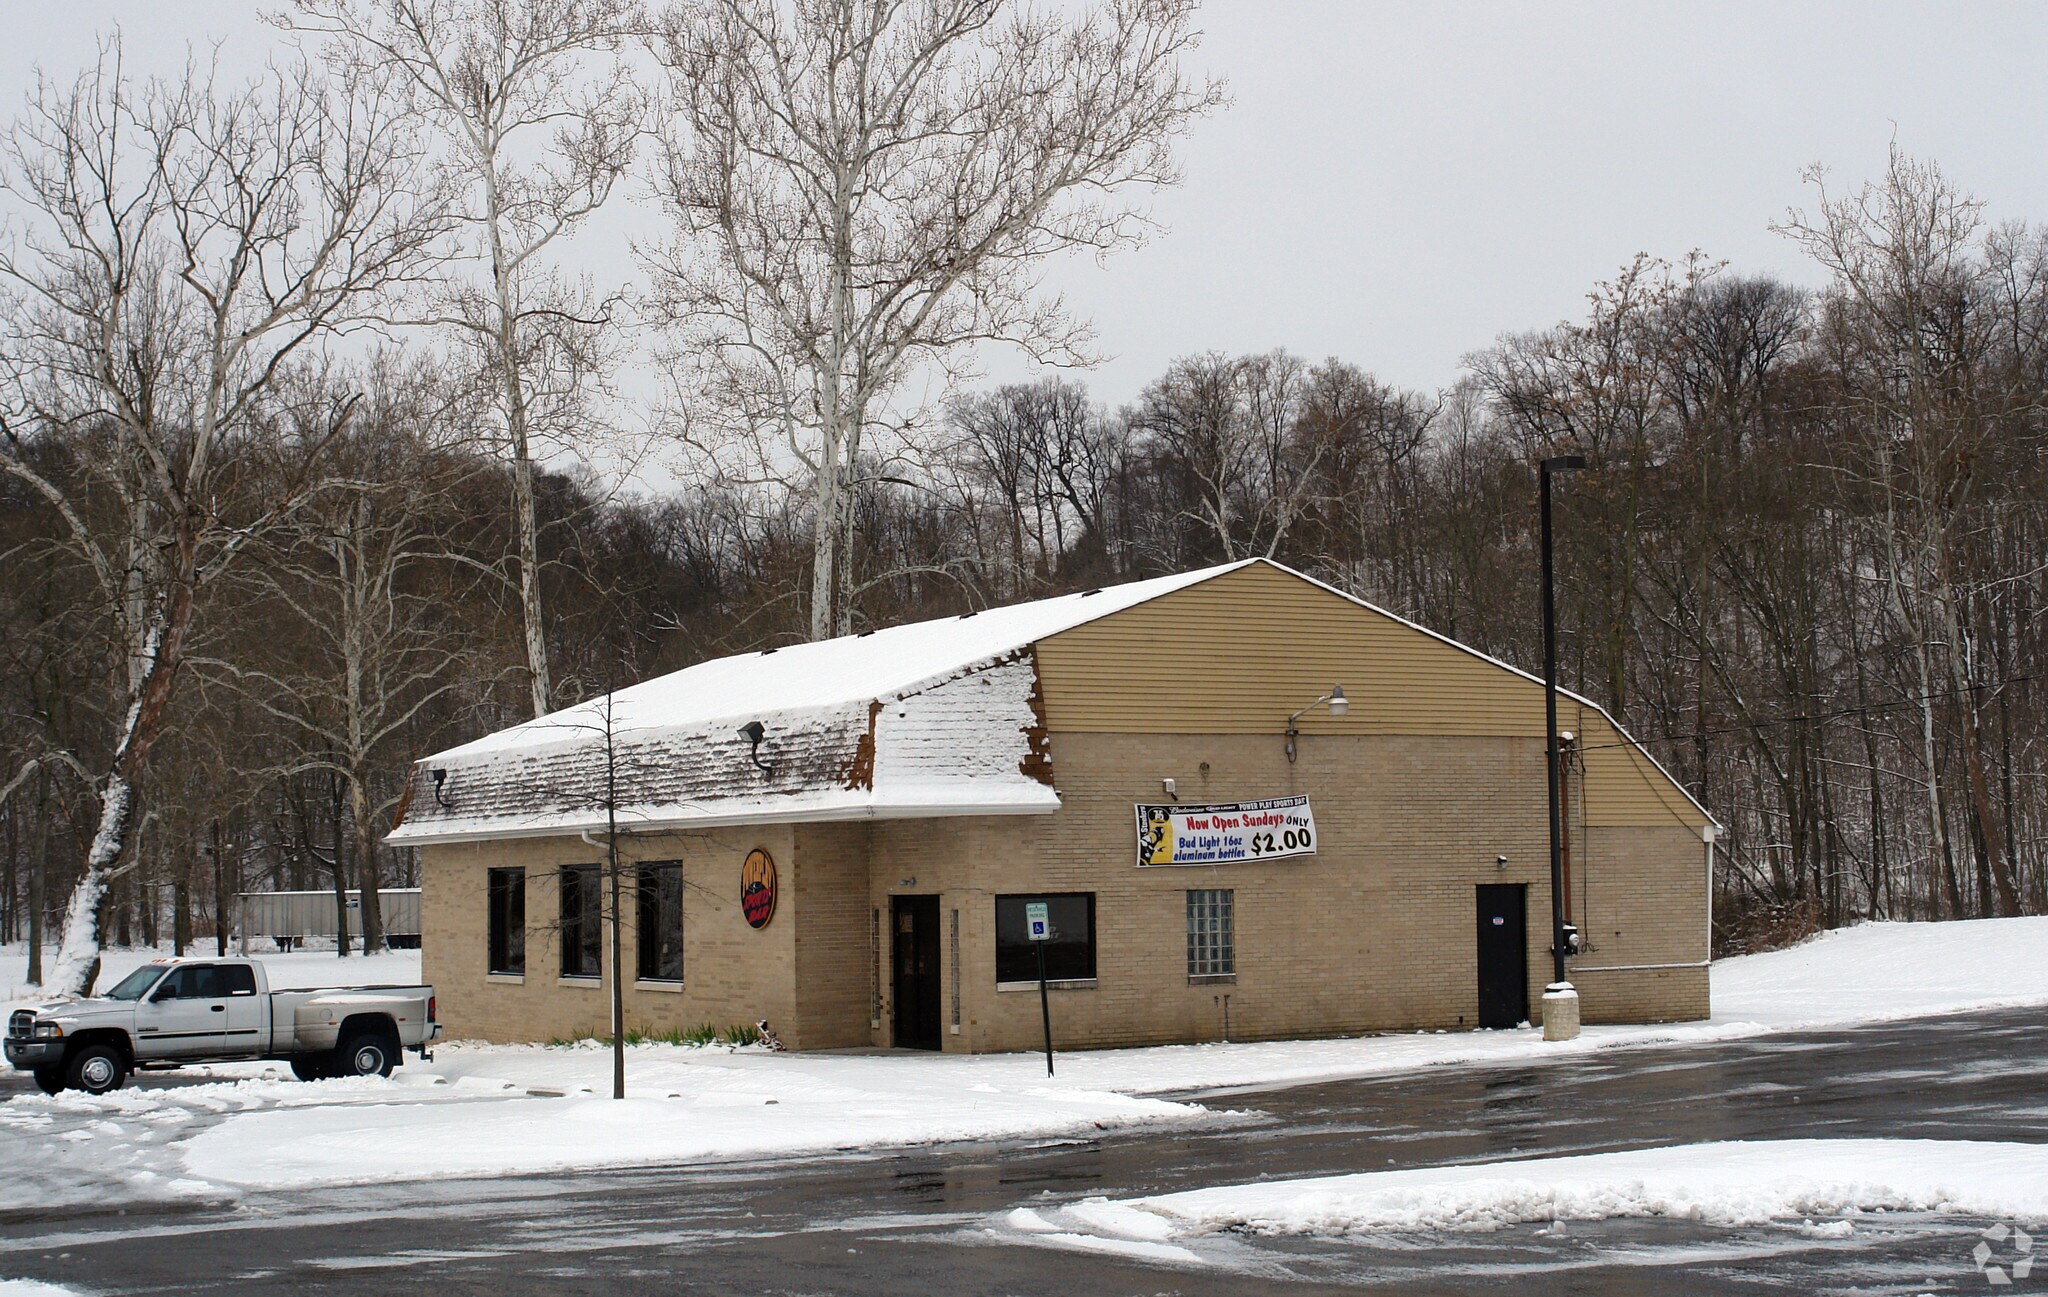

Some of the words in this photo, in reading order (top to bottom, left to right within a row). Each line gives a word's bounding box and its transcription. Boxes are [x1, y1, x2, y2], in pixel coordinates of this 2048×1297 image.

[1239, 802, 1258, 811] POWER
[1259, 801, 1273, 809] PLAY
[1273, 799, 1294, 808] SPORTS
[1294, 797, 1306, 805] BAR
[1140, 806, 1148, 833] Steelers
[1186, 816, 1209, 831] Now
[1212, 815, 1240, 833] Open
[1242, 811, 1285, 828] Sundays
[1286, 815, 1309, 828] ONLY
[1179, 836, 1196, 848] Bud
[1199, 836, 1220, 851] Light
[1223, 835, 1243, 846] 16oz
[1251, 828, 1311, 856] $2.00
[1173, 849, 1216, 861] aluminum
[1218, 847, 1246, 859] bottles
